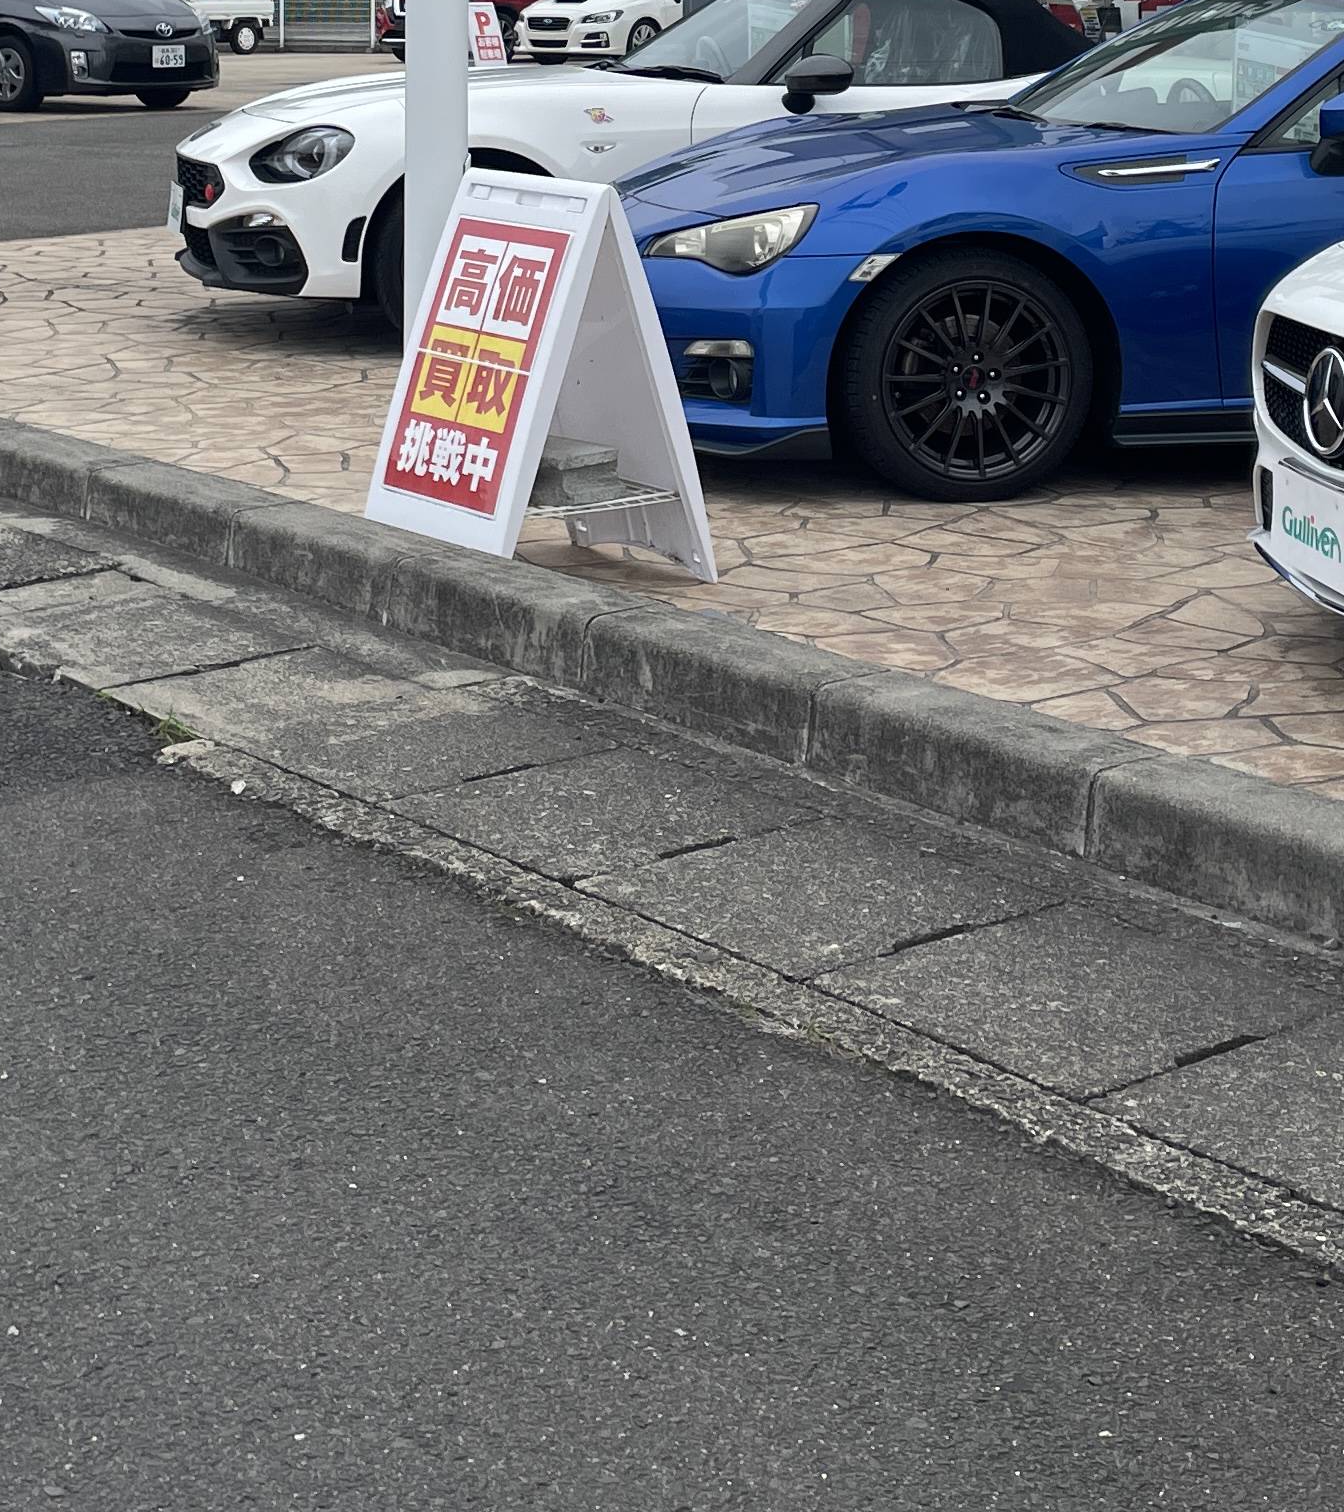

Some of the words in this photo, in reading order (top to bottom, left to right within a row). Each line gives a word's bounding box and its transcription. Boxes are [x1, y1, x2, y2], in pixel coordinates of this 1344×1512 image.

[475, 11, 491, 35] P
[444, 248, 547, 327] 高価
[419, 338, 520, 417] 買取
[396, 418, 499, 493] 挑戦中
[1282, 506, 1341, 563] Gulliver
